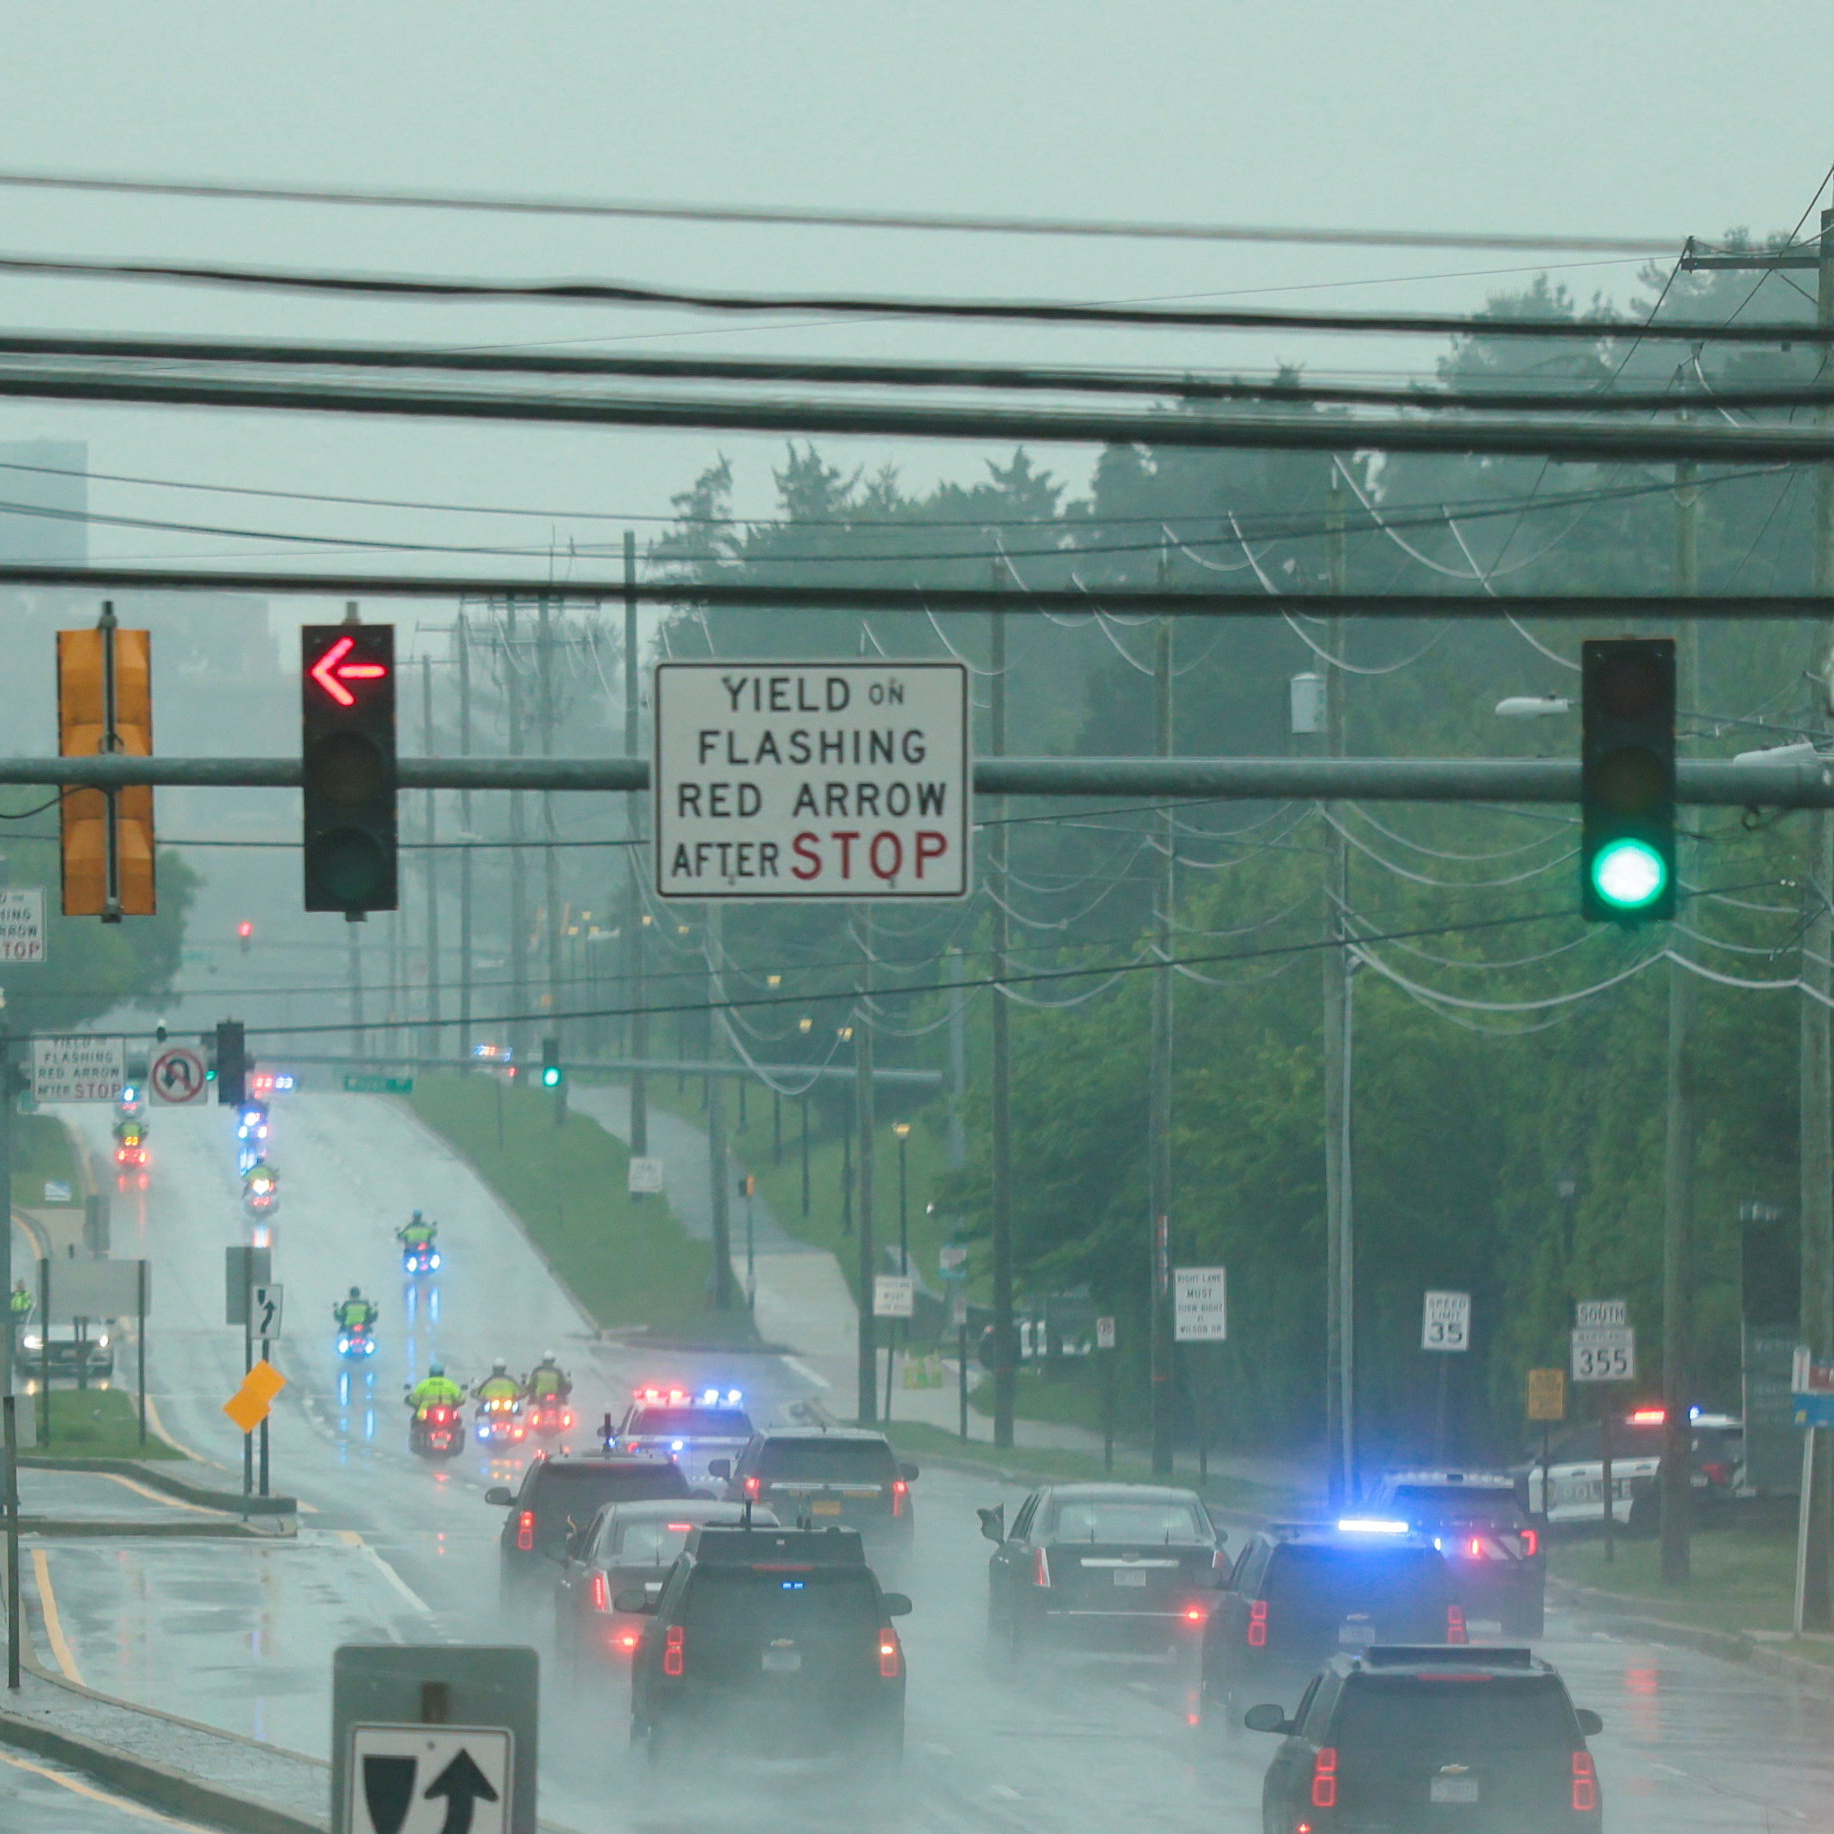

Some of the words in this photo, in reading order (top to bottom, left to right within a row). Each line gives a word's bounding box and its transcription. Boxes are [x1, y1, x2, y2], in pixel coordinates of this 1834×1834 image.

[722, 676, 850, 712] YIELD
[869, 682, 904, 706] ON
[698, 730, 926, 765] FLASHING
[678, 783, 762, 818] RED
[793, 782, 947, 817] ARROW
[671, 842, 780, 878] AFTER
[790, 831, 948, 881] STOP
[44, 1050, 113, 1063] FLASHING
[38, 1067, 65, 1080] RED
[73, 1067, 119, 1080] ARROW
[74, 1083, 122, 1099] STOP
[1186, 1287, 1213, 1300] MUST
[1579, 1305, 1624, 1322] SOUTH
[1429, 1321, 1463, 1343] 35
[1579, 1349, 1627, 1376] 355
